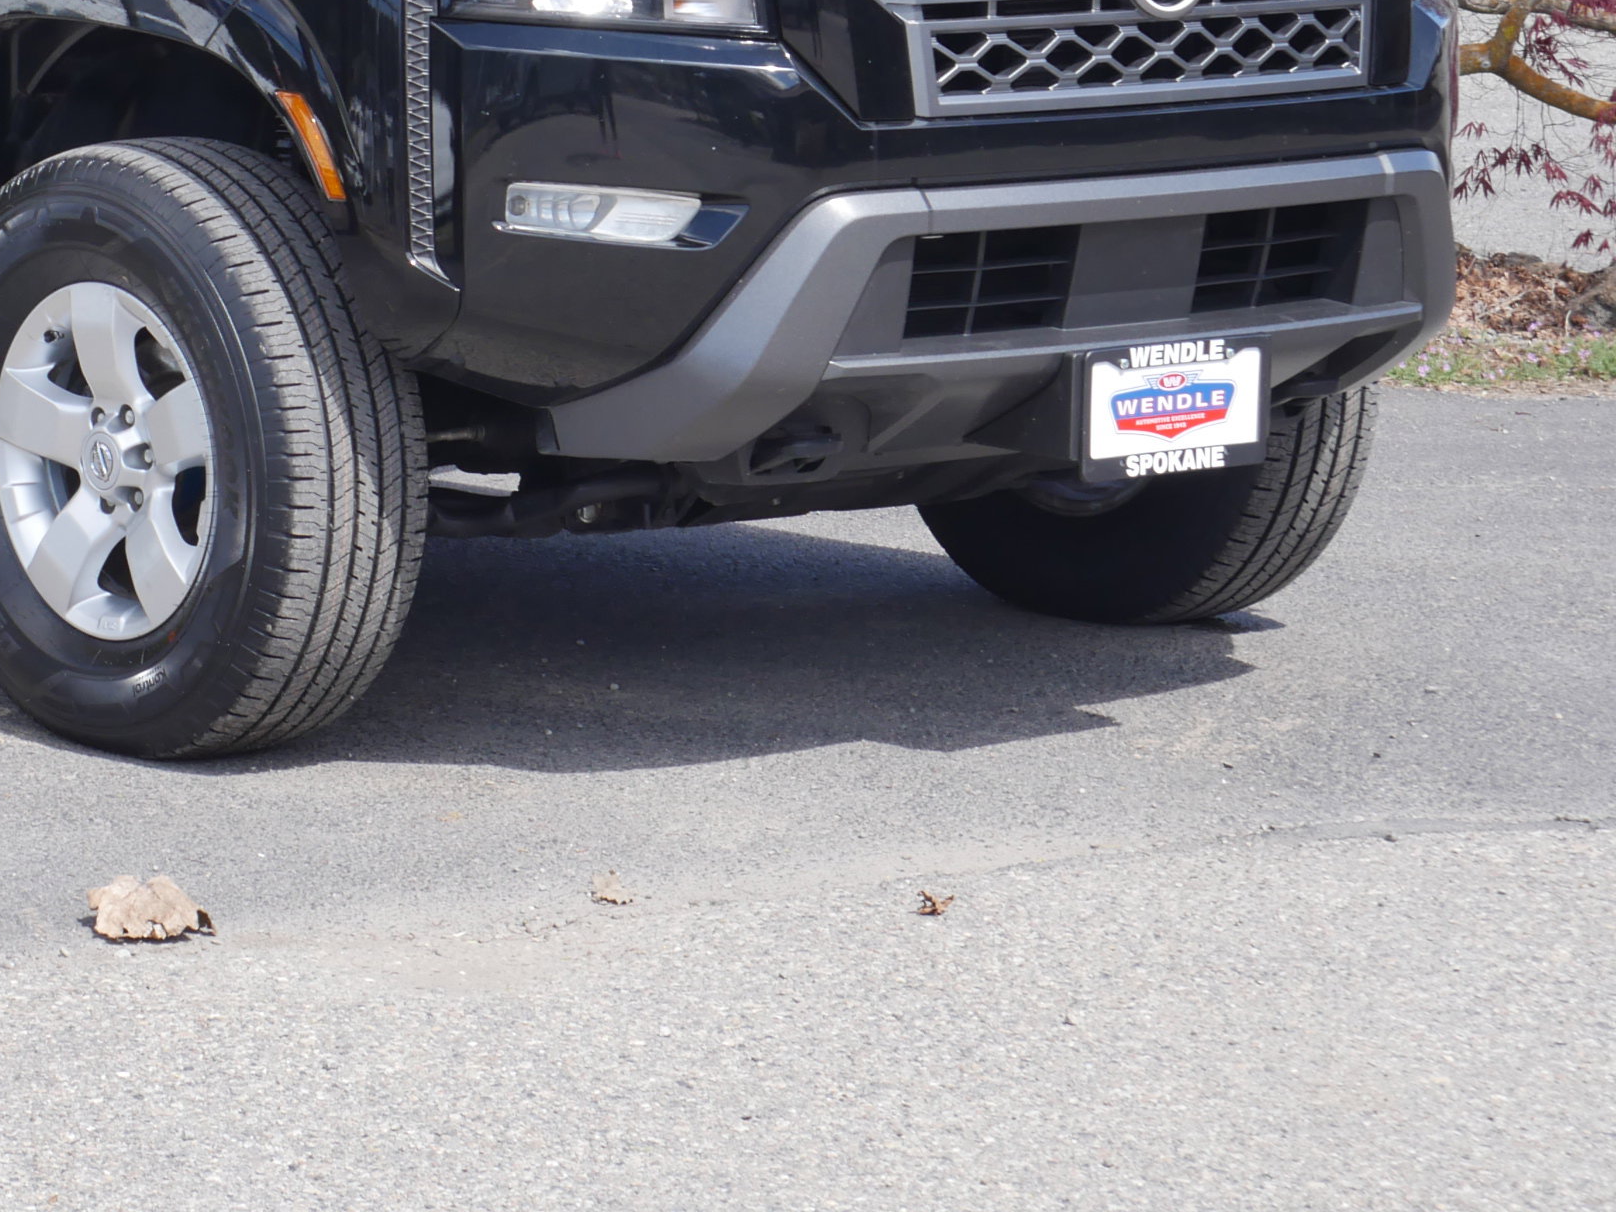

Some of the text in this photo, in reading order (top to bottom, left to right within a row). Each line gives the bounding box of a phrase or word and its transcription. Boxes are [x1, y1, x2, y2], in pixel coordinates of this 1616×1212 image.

[1129, 338, 1226, 369] WENDLE
[1115, 389, 1226, 417] WENDLE
[1125, 445, 1226, 478] SPOKANE
